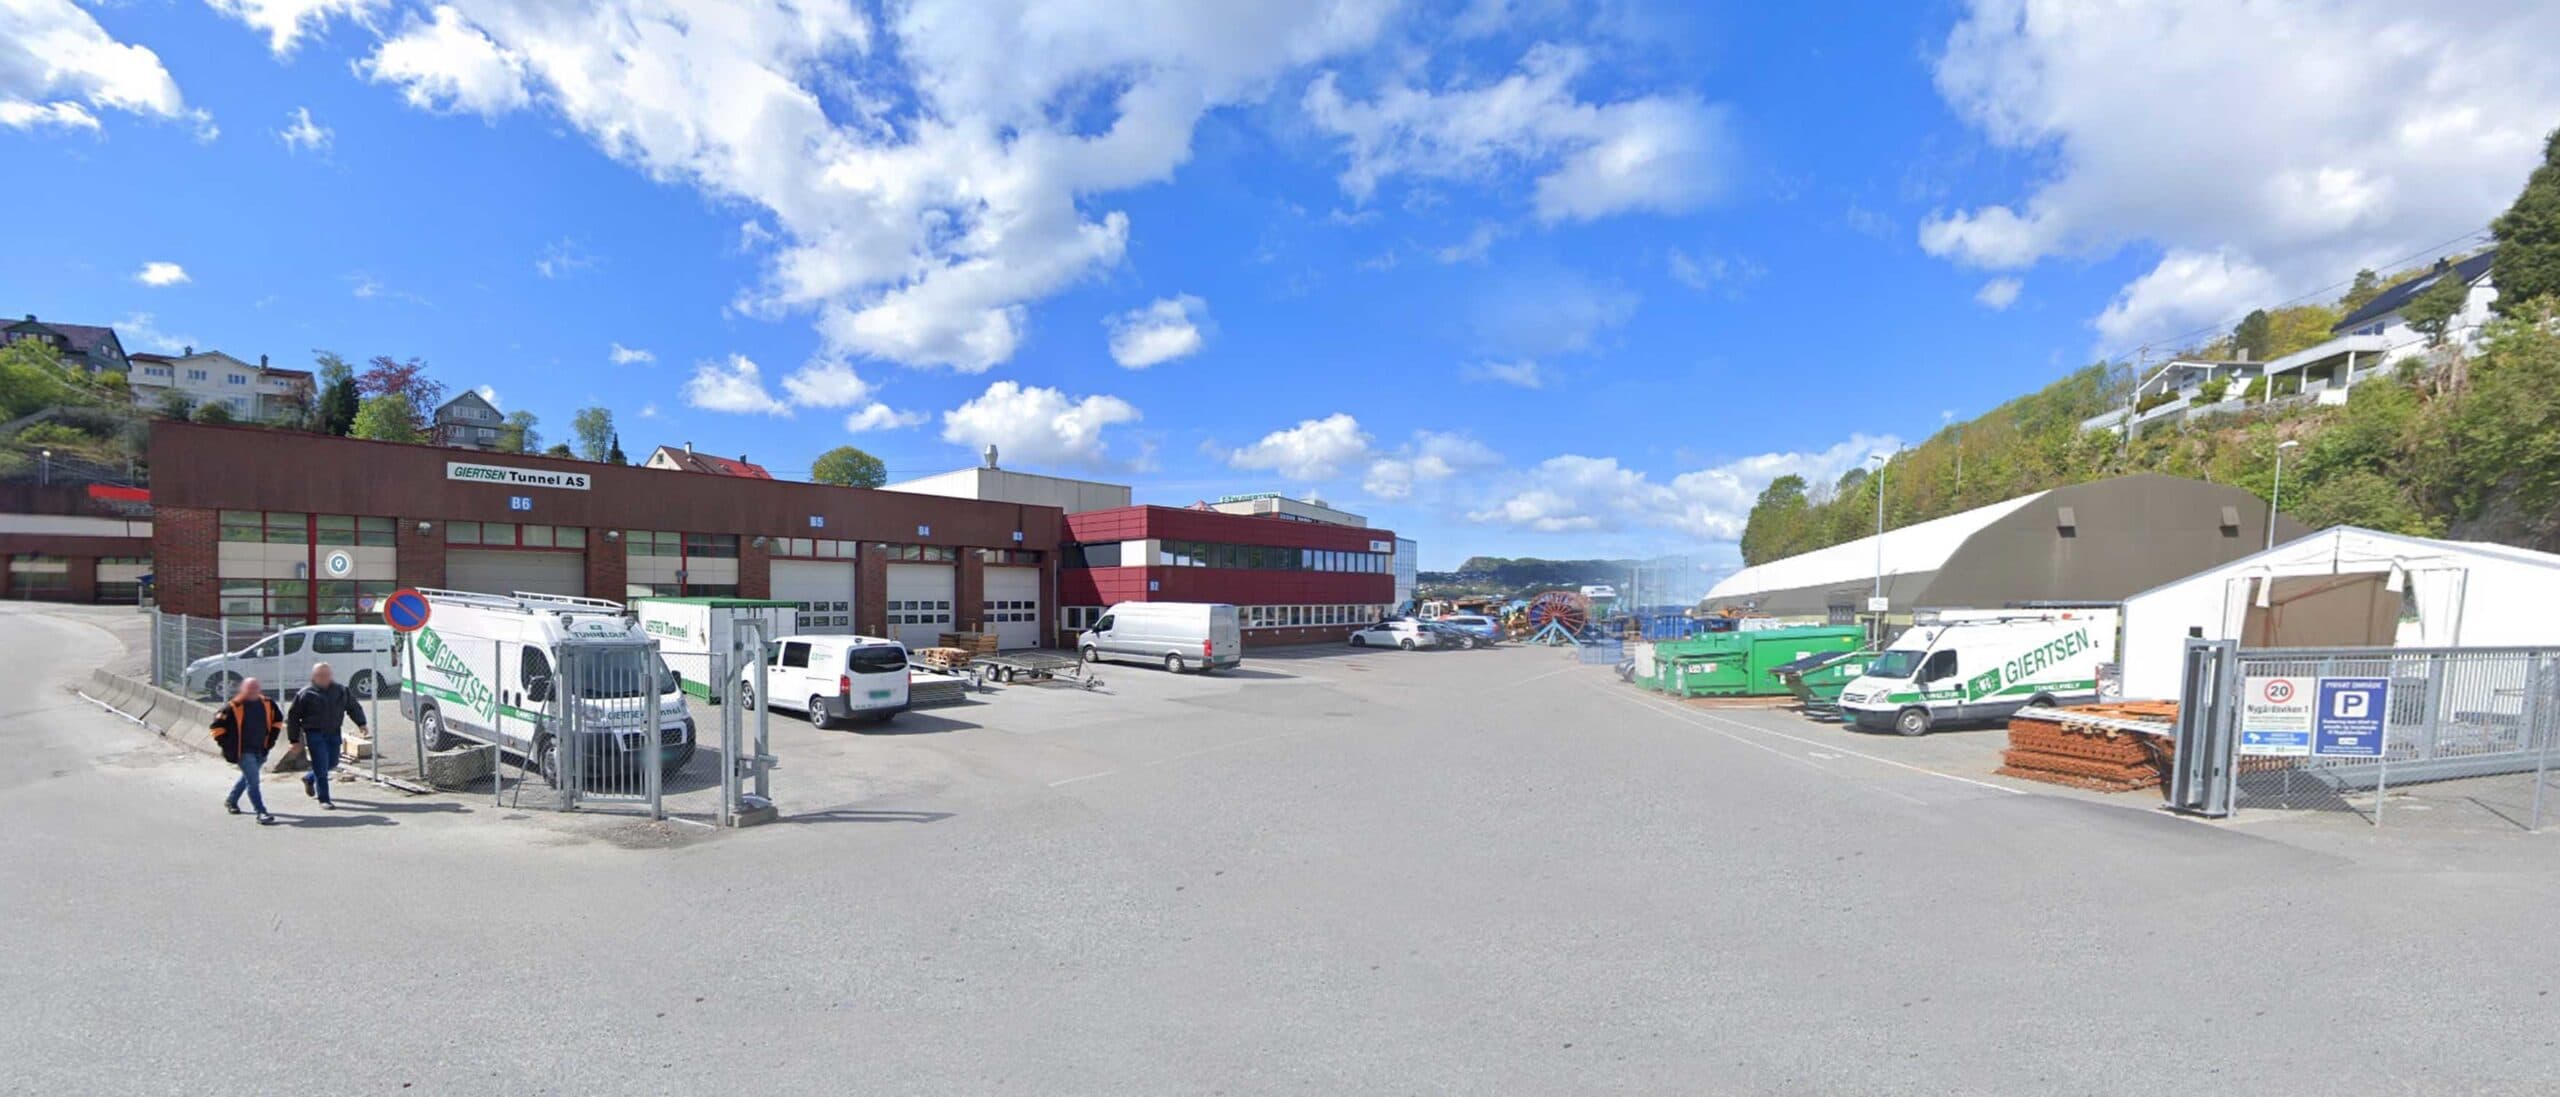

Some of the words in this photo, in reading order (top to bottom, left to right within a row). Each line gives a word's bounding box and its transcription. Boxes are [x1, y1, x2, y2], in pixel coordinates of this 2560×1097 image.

[454, 466, 507, 480] GIERTSEN
[509, 471, 561, 485] Tunnel
[565, 476, 585, 487] AS
[511, 496, 531, 510] B6
[810, 516, 824, 527] B5
[917, 525, 930, 536] B4
[665, 622, 688, 638] Tunnel
[2005, 627, 2090, 684] GIERTSEN
[434, 643, 496, 723] GIERTSEN
[2270, 686, 2289, 697] 20
[2343, 694, 2363, 714] P
